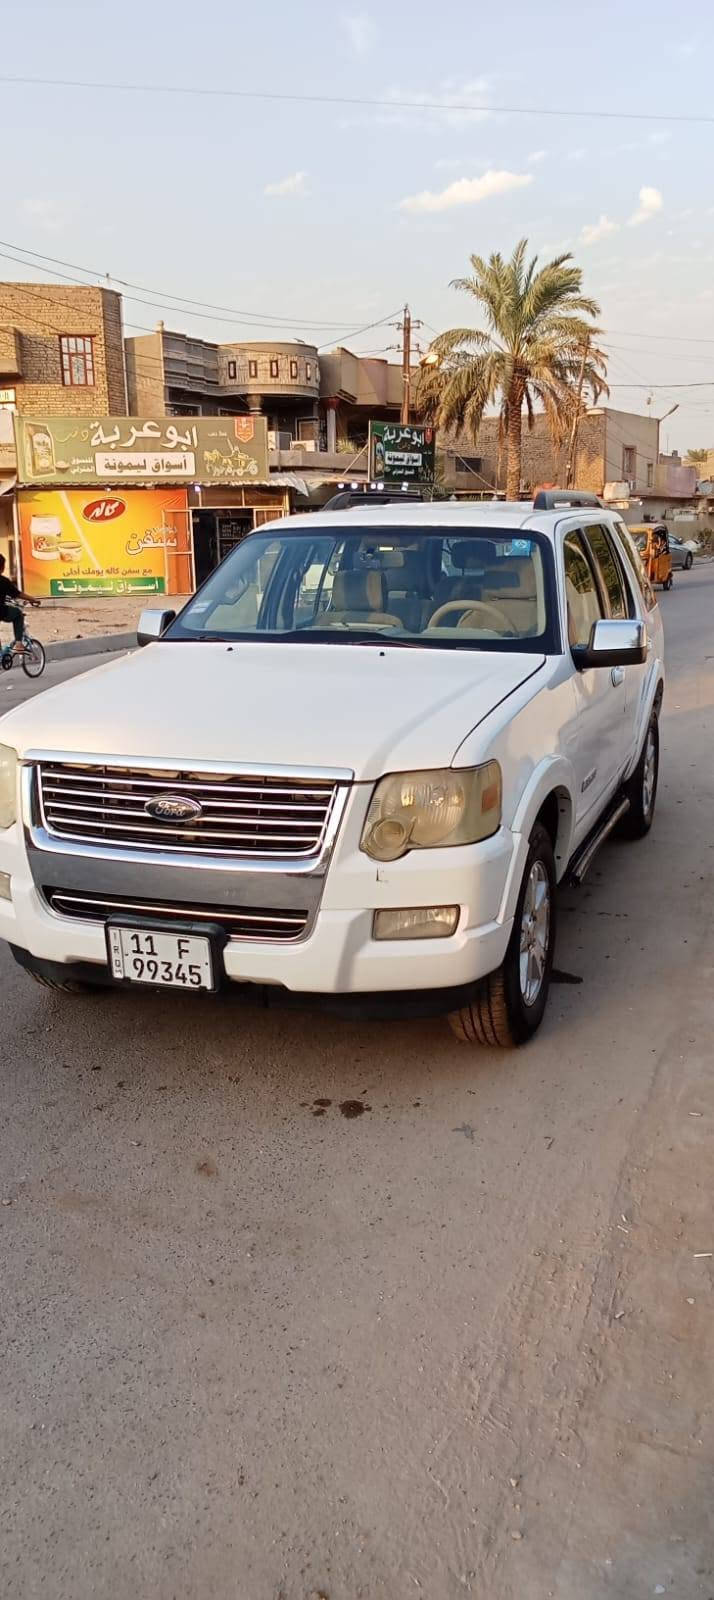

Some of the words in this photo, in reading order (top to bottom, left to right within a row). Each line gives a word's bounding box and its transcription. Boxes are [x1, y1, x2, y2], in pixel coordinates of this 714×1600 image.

[90, 420, 161, 450] عربة
[160, 424, 198, 451] ابو
[383, 425, 411, 444] عربة
[104, 458, 147, 473] ليمونة
[152, 455, 187, 473] أسواق
[142, 569, 153, 577] مع
[57, 580, 114, 595] ليمونة
[155, 800, 187, 816] Ford
[131, 933, 159, 956] 11
[177, 938, 191, 960] F
[132, 957, 203, 986] 99345
